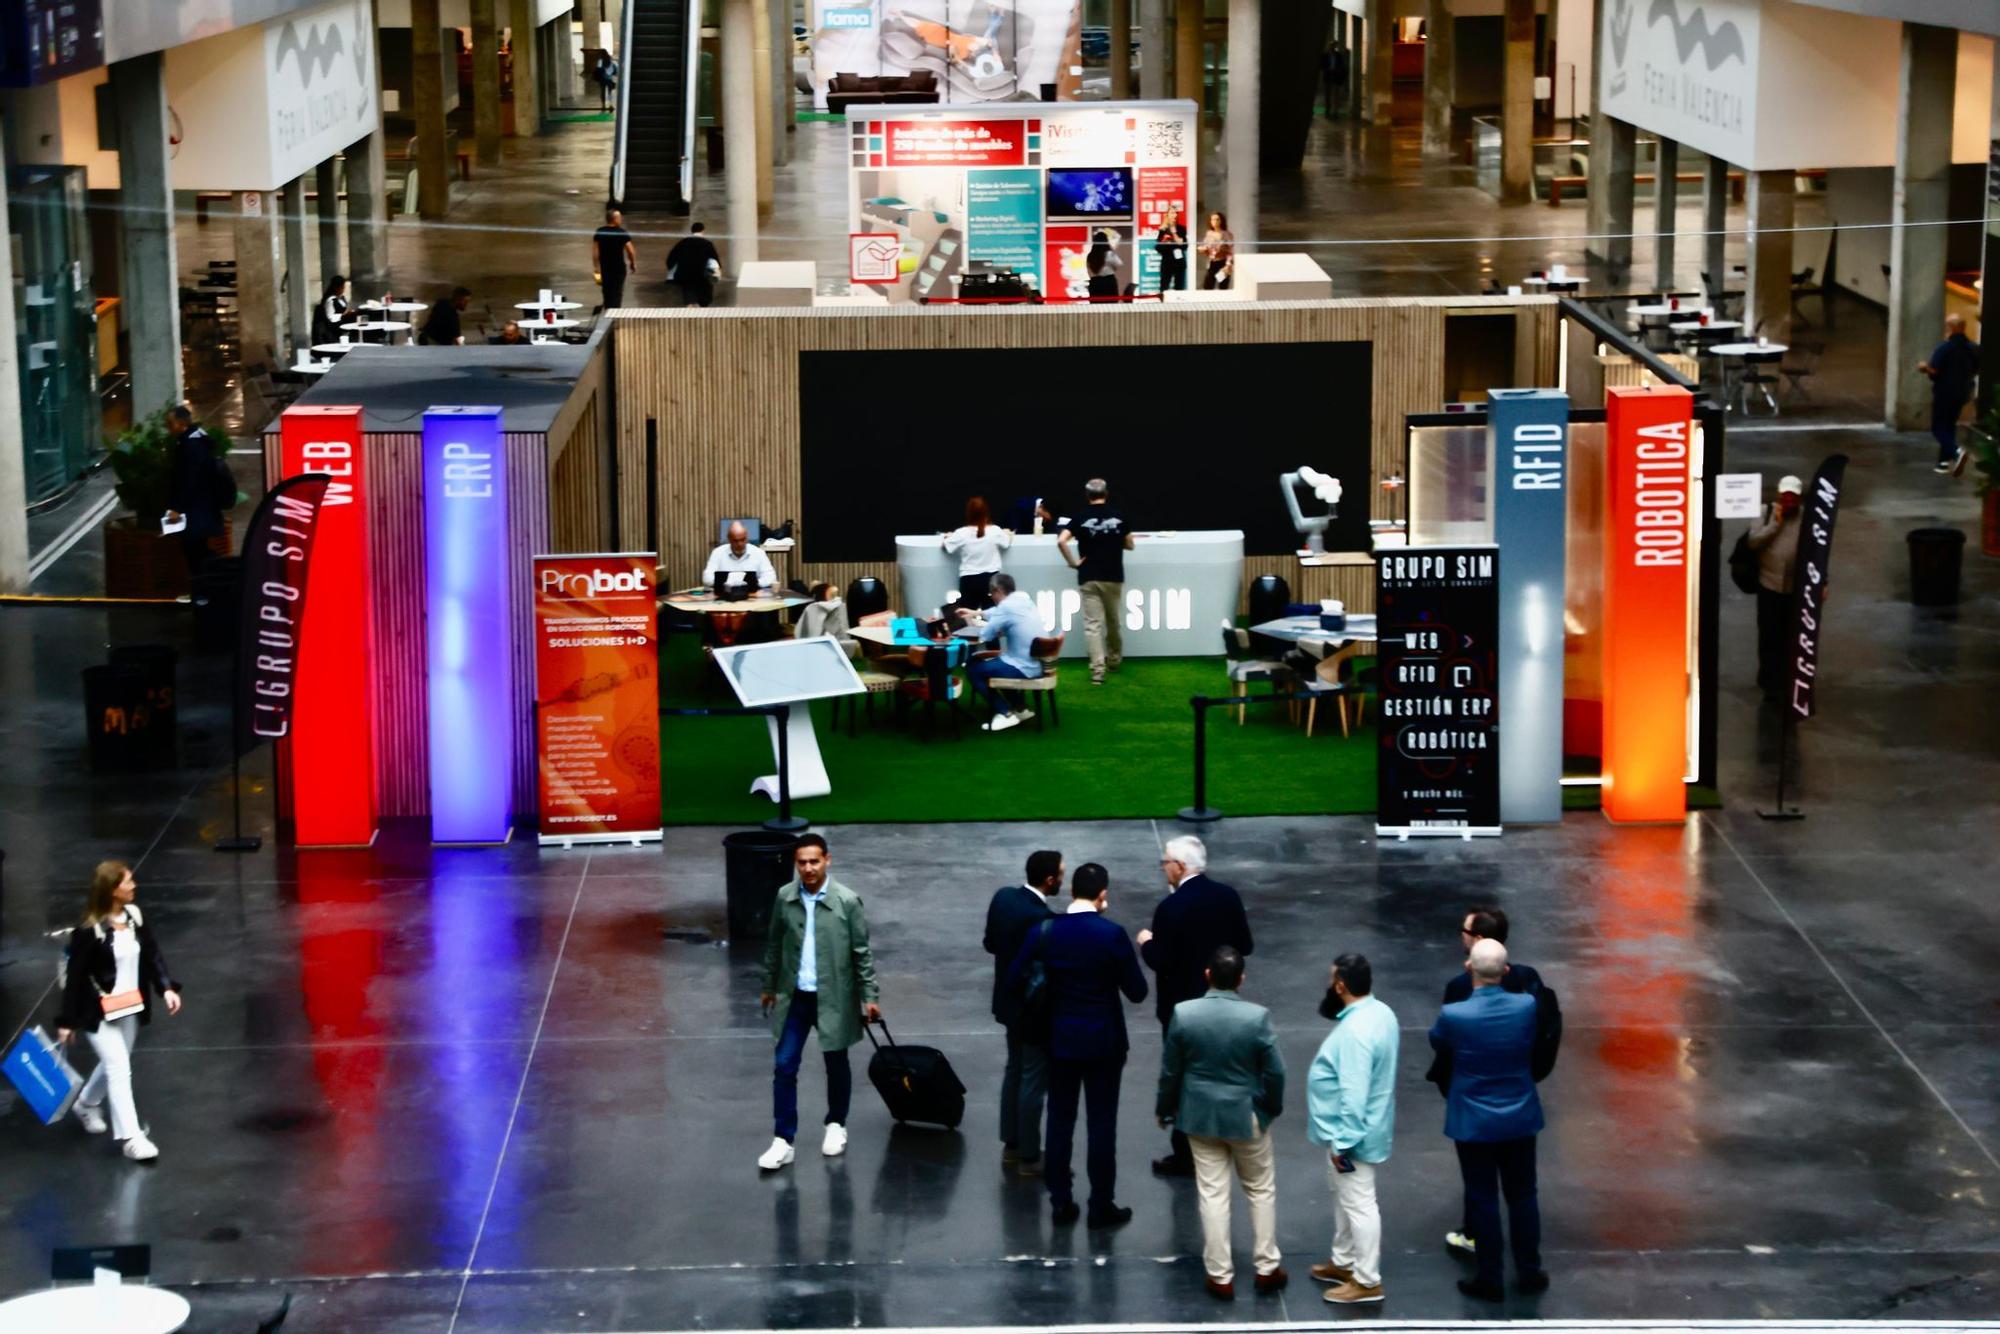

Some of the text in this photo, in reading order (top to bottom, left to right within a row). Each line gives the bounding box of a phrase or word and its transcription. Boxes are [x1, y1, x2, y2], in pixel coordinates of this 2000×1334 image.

[826, 11, 869, 26] fama
[1643, 63, 1677, 110] FERIA
[1682, 72, 1743, 134] VALENCIA
[443, 443, 492, 498] ERP
[1513, 423, 1563, 491] RFID
[303, 441, 354, 507] WEB
[1635, 421, 1687, 567] ROBOTICA
[1382, 555, 1492, 580] GRUPO SIM
[255, 495, 315, 699] GRUPO SIM
[542, 568, 648, 597] Probot
[1126, 588, 1191, 631] SIM
[549, 635, 647, 648] SOLUCIONES I+D
[1405, 632, 1438, 650] WEB
[1399, 665, 1436, 684] RFID
[1384, 696, 1492, 717] GESTIÓN ERP
[1407, 729, 1487, 750] ROBÓTICA
